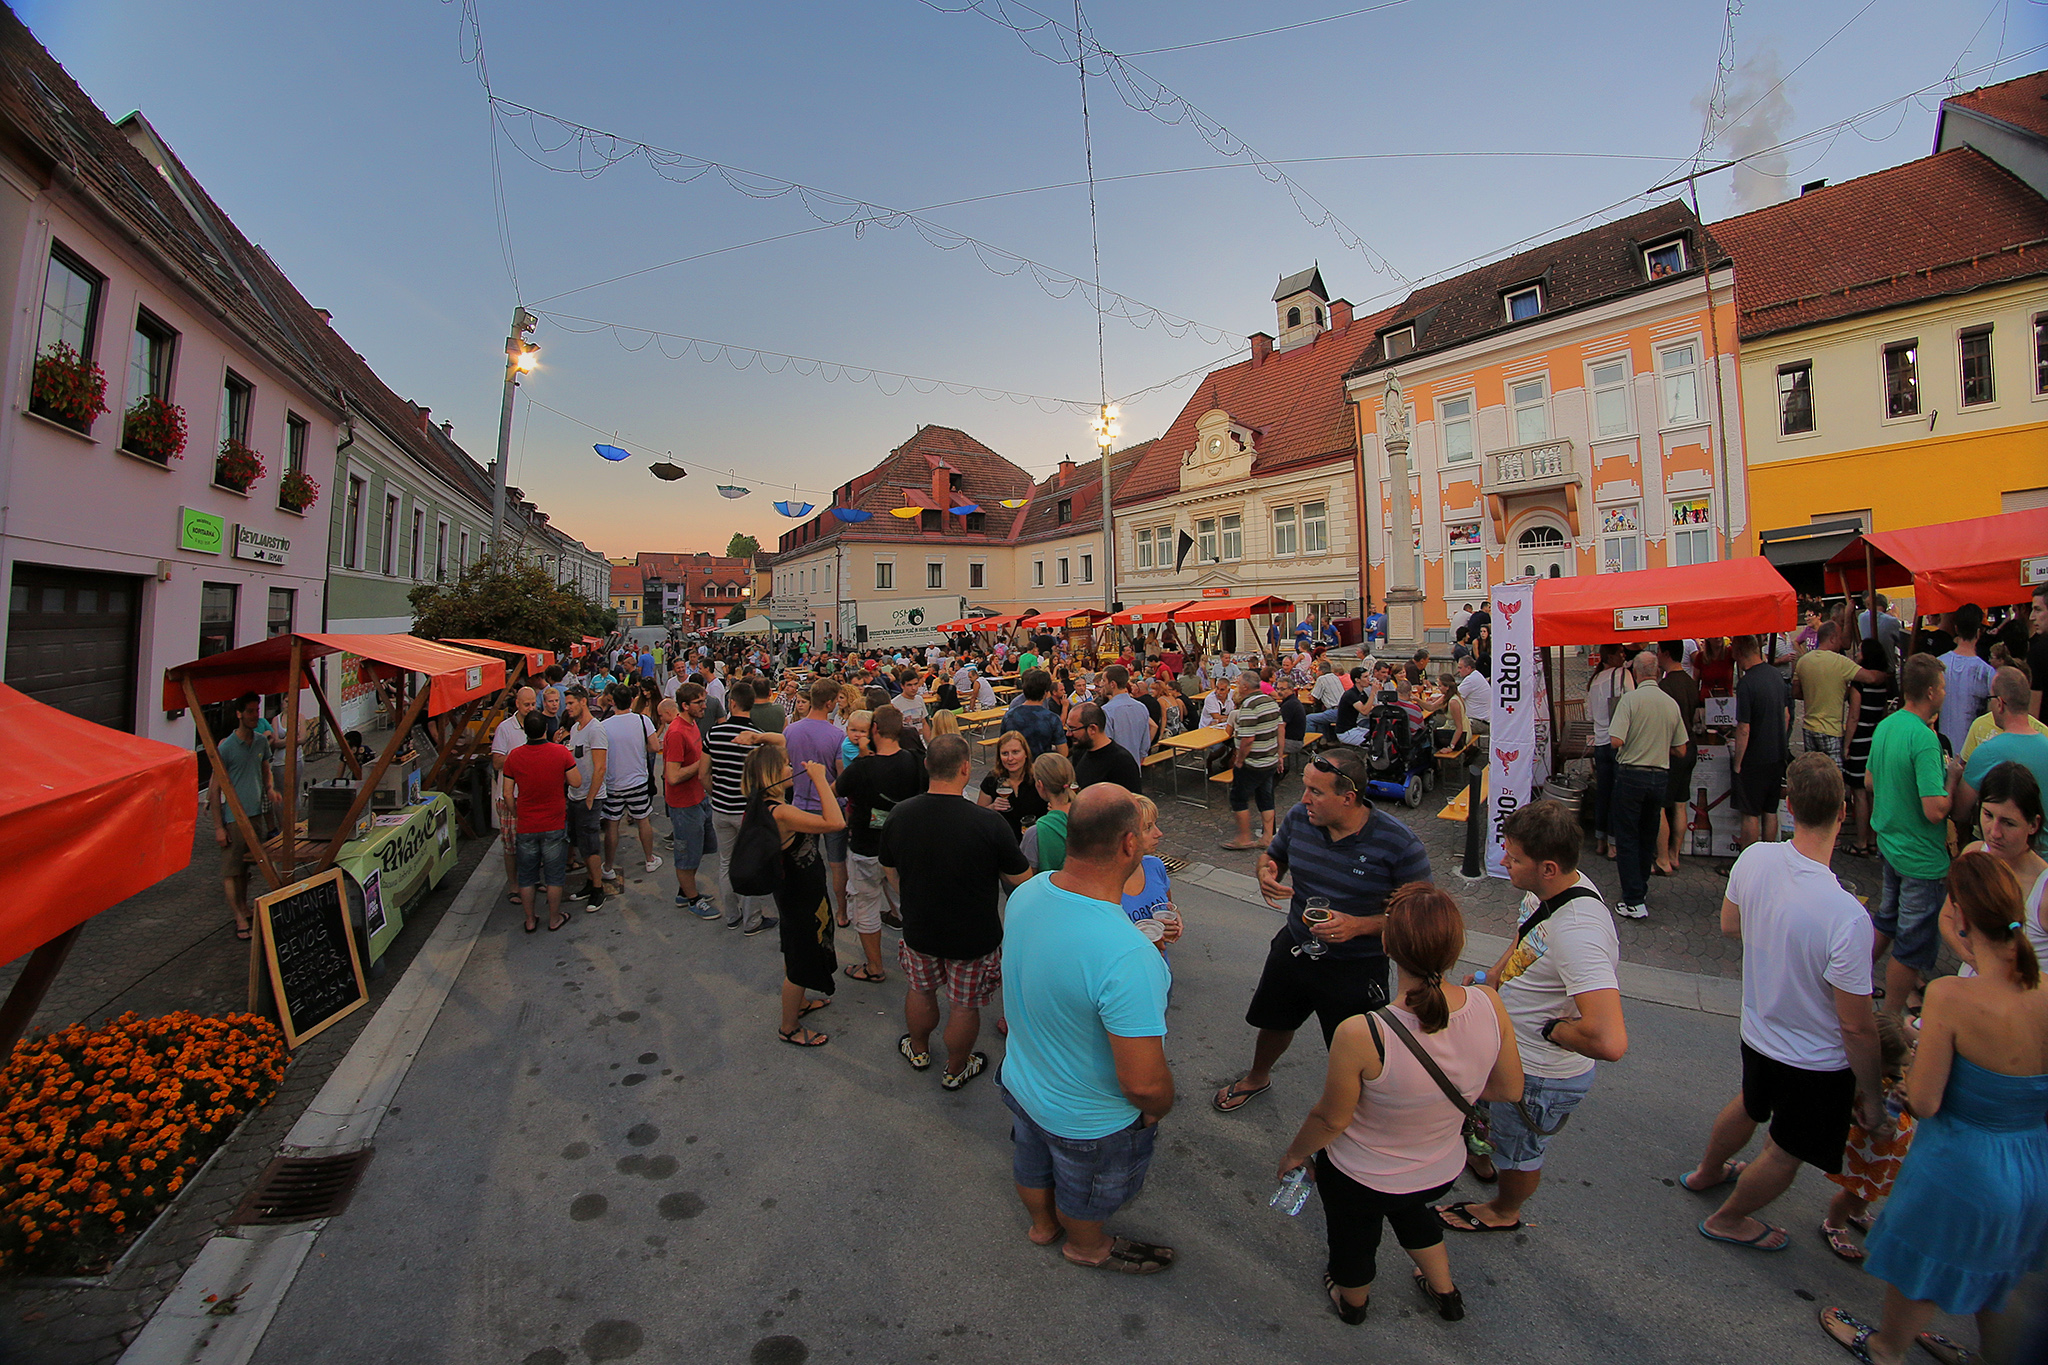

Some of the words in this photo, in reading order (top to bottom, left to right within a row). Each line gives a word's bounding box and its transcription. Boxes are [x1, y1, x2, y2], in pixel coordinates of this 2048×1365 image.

[240, 527, 291, 551] ČEVLJARSTVO
[1505, 643, 1517, 651] Dr.
[1498, 652, 1521, 708] OREL
[1714, 715, 1731, 724] OREL
[278, 924, 327, 963] BEVOG
[319, 955, 347, 979] DOGS
